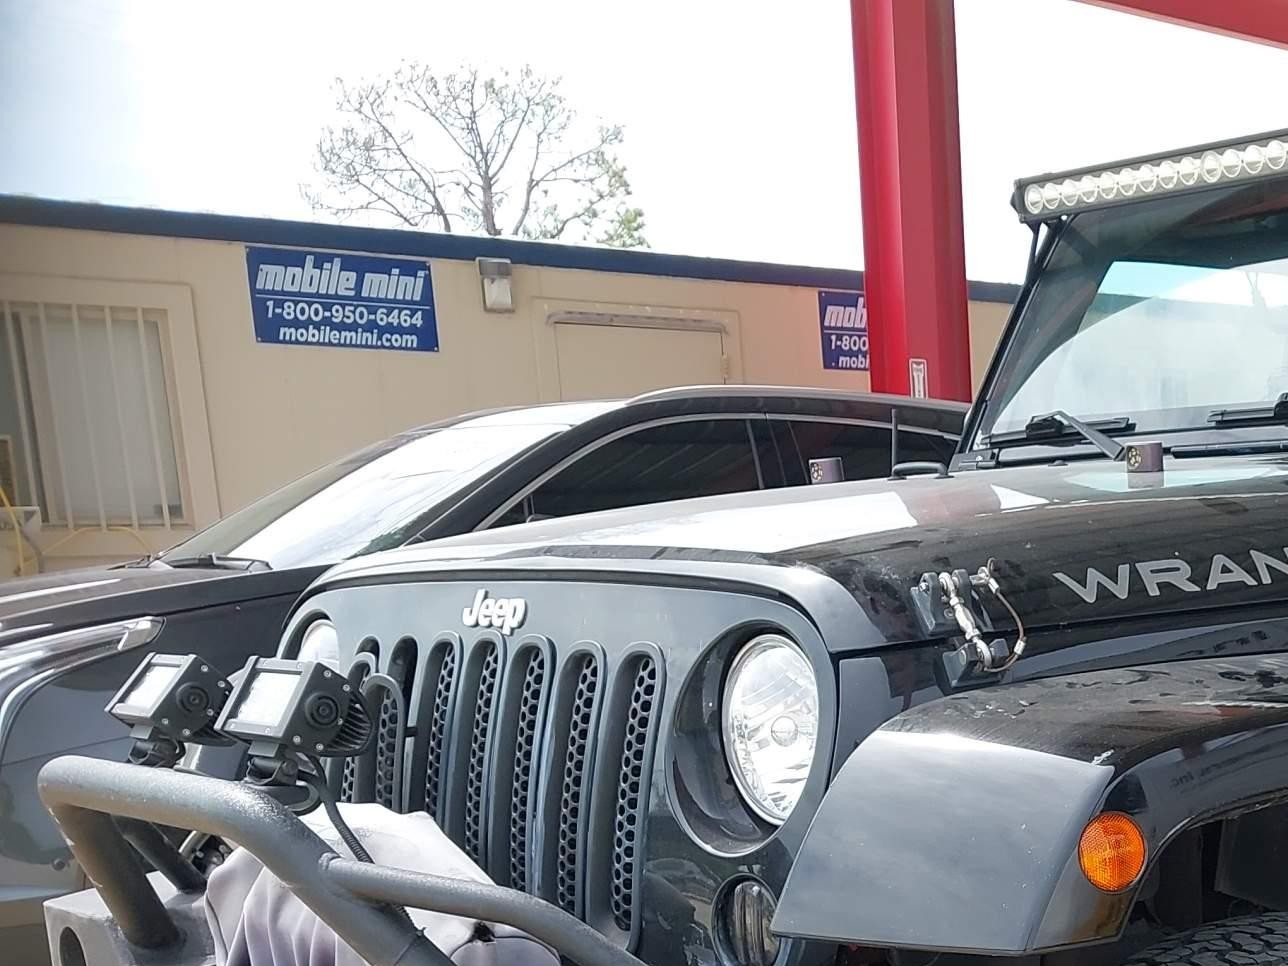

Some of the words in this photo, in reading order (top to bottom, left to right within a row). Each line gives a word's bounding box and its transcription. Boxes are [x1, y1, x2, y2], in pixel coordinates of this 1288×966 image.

[255, 255, 357, 297] mobile
[361, 268, 426, 301] mini
[266, 301, 423, 328] 1-800-950-6464
[279, 325, 418, 348] mobilemini.com
[462, 588, 527, 636] Jeep
